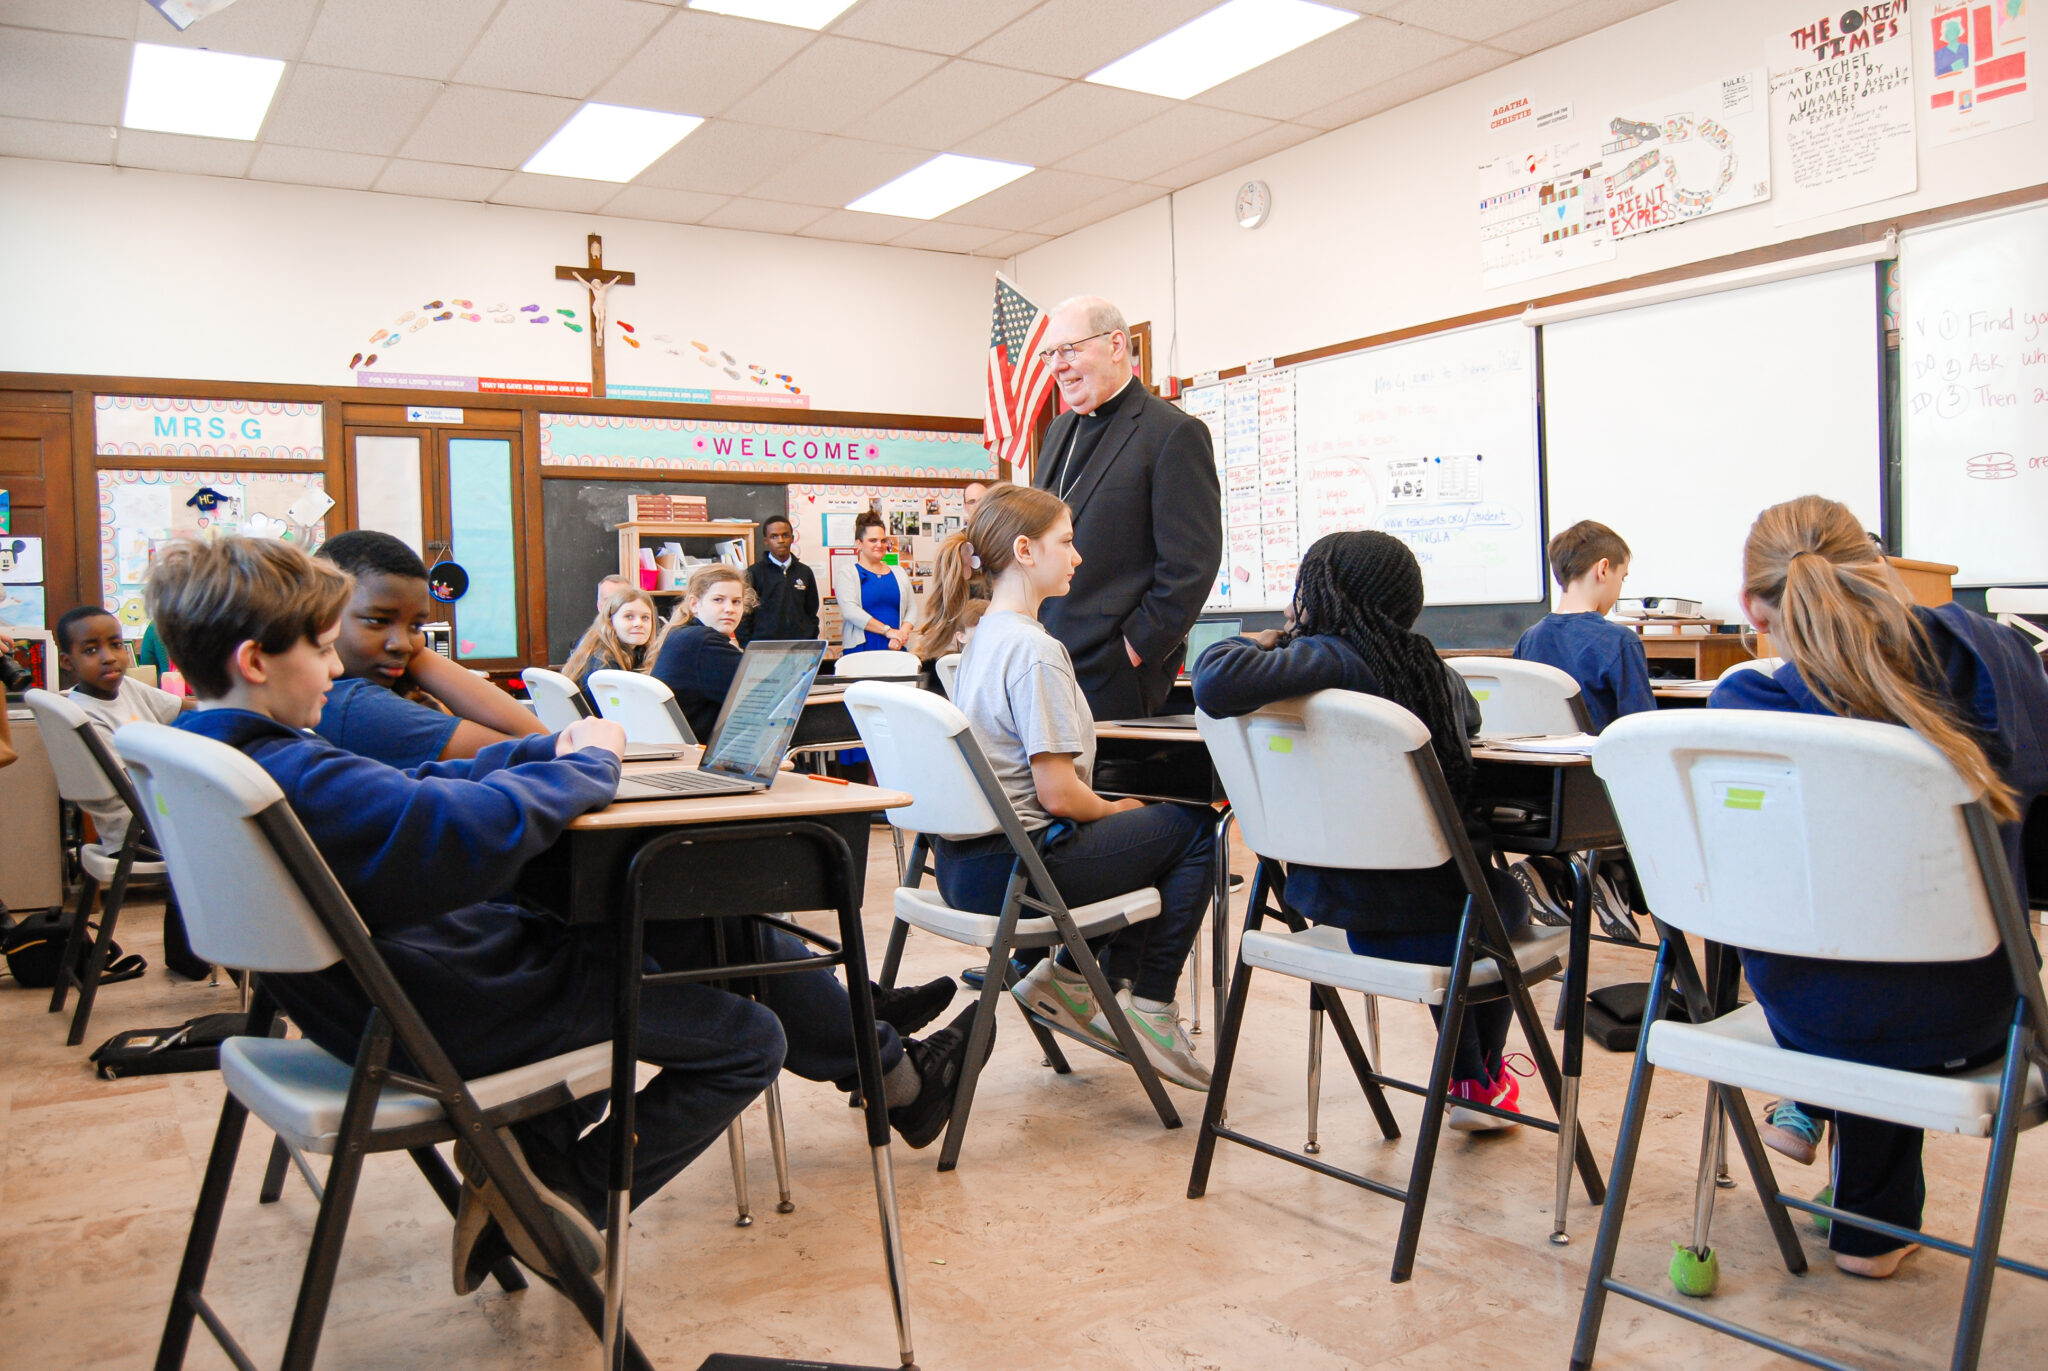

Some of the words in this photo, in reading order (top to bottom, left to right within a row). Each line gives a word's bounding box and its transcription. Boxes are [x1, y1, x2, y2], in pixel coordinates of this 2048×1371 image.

[1790, 17, 1830, 50] THE
[1840, 0, 1908, 34] ORIENT
[1813, 18, 1897, 61] TIMES
[1805, 52, 1869, 83] RATCHET
[1787, 71, 1860, 104] MURDERED
[1865, 64, 1883, 76] BY
[1490, 108, 1532, 129] CHRISTIE
[1493, 97, 1528, 117] AGATHA
[1609, 184, 1665, 218] ORIENT
[1616, 186, 1634, 202] THE
[1611, 200, 1677, 236] EXPRESS
[1968, 307, 2014, 336] Find
[480, 381, 497, 390] THAT
[497, 382, 506, 390] HE
[506, 383, 522, 391] GAVE
[534, 384, 546, 392] ONE
[559, 385, 575, 393] ONLY
[1974, 384, 2017, 408] Then
[713, 437, 860, 460] WELCOME
[199, 493, 215, 505] HC
